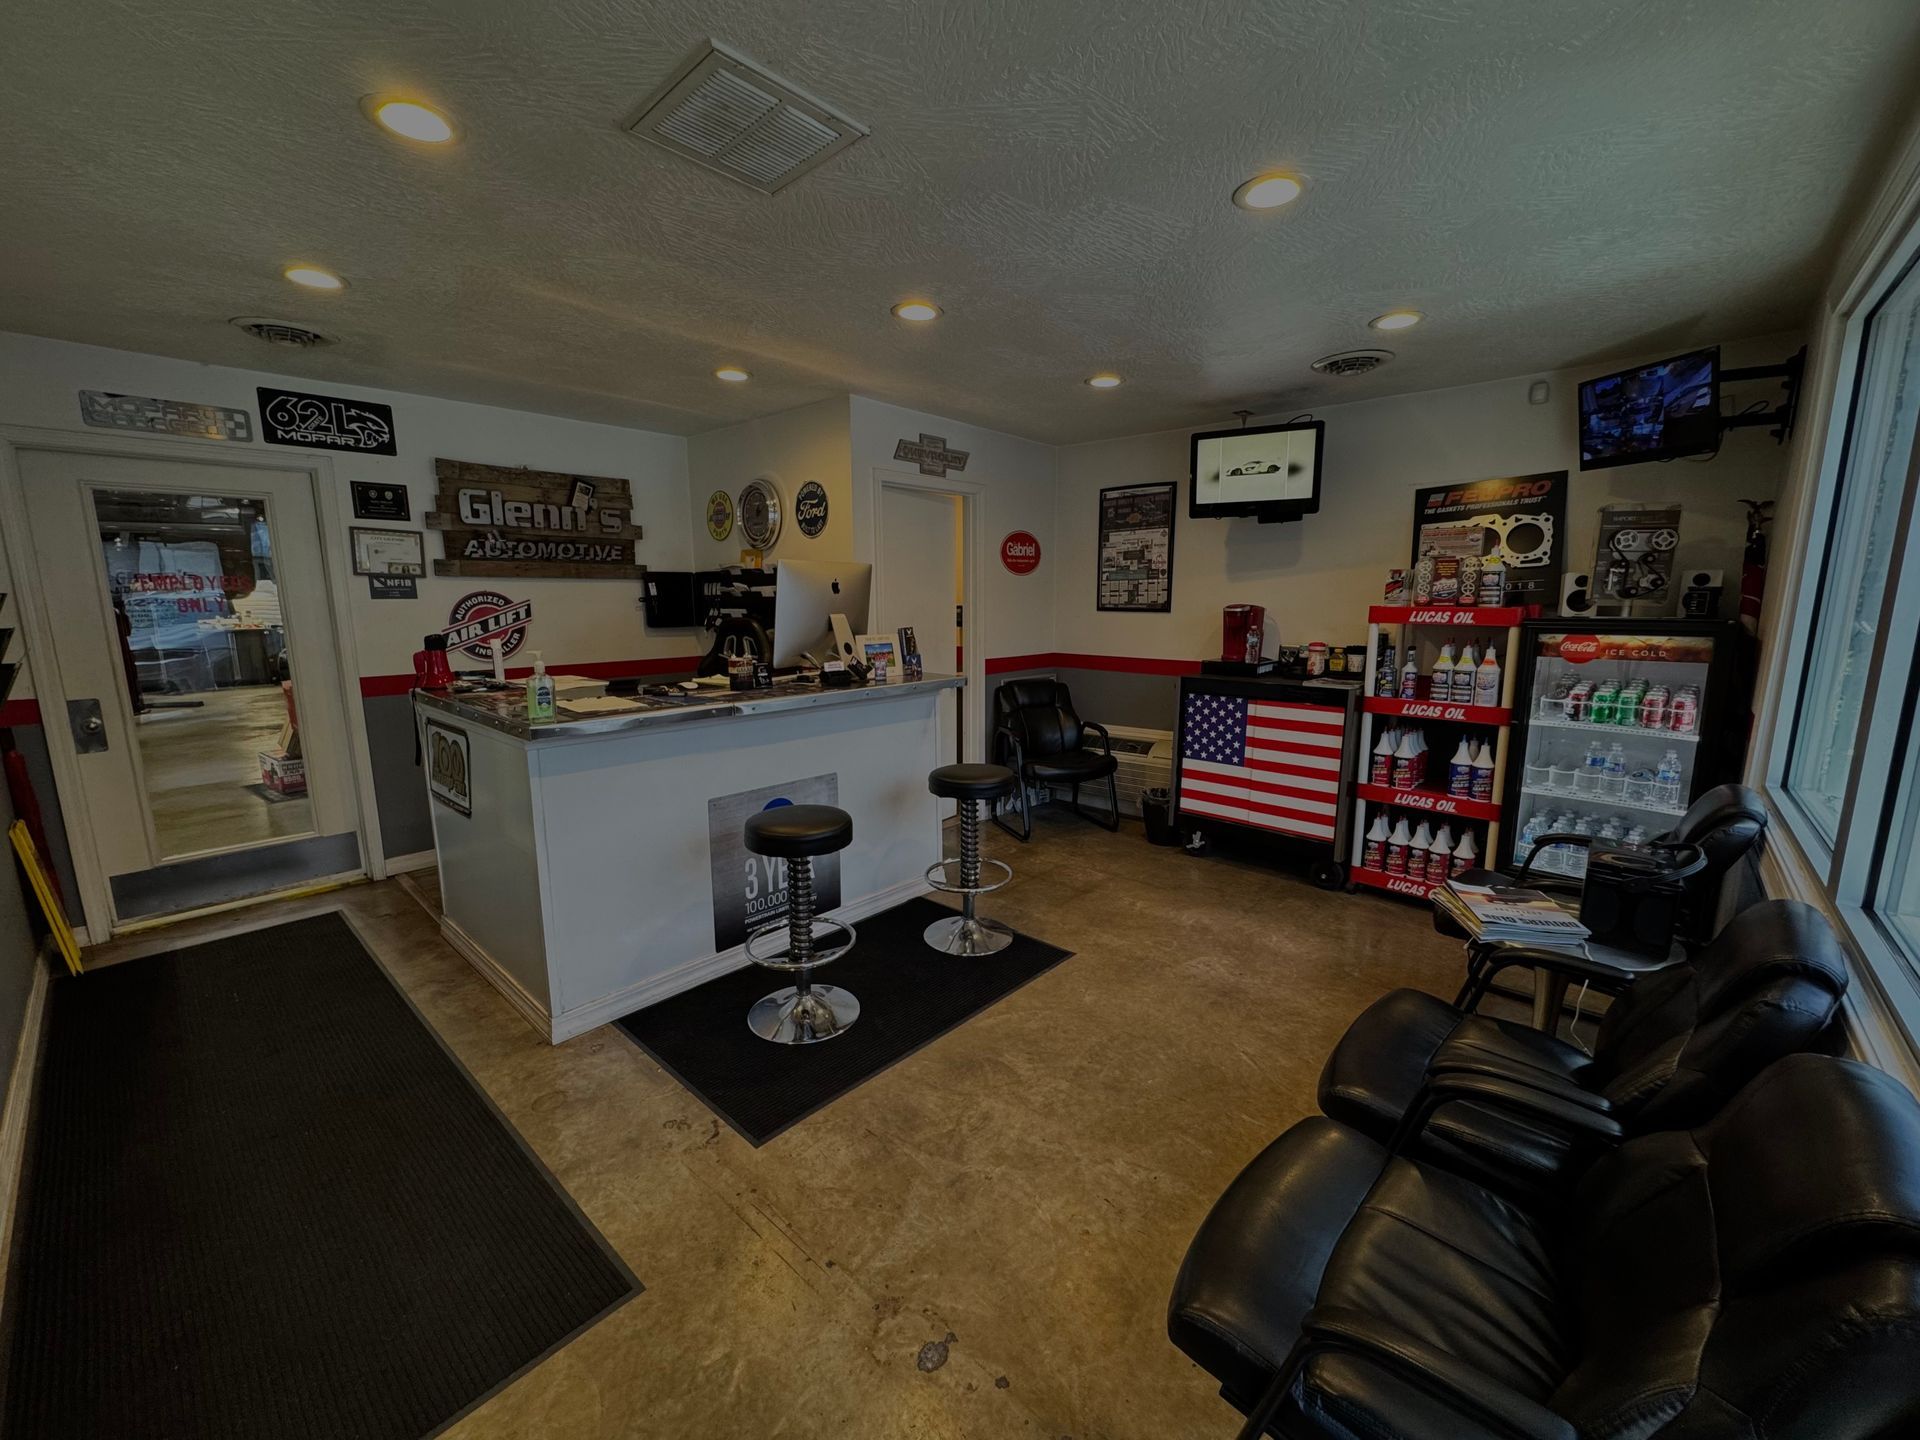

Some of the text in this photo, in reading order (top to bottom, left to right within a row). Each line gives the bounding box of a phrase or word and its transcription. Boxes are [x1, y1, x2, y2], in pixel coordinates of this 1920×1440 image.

[277, 429, 355, 447] MOPAR
[798, 499, 826, 520] Ford
[1436, 505, 1465, 514] GASKETS
[464, 538, 624, 561] AUTOMOTIVE
[1007, 541, 1035, 557] Gabriel
[386, 578, 412, 587] NFIB
[177, 597, 225, 613] ONLY
[455, 595, 505, 620] AUTHORIZED
[447, 605, 528, 647] AIR LIFT
[1408, 611, 1475, 624] LUCAS OIL
[1560, 641, 1599, 653] Coca-Cola
[1605, 649, 1668, 657] ICE COLD
[1401, 703, 1466, 720] LUCAS OIL
[1394, 792, 1458, 813] LUCAS OIL
[744, 857, 758, 900] 3
[1386, 878, 1426, 897] LUCAS
